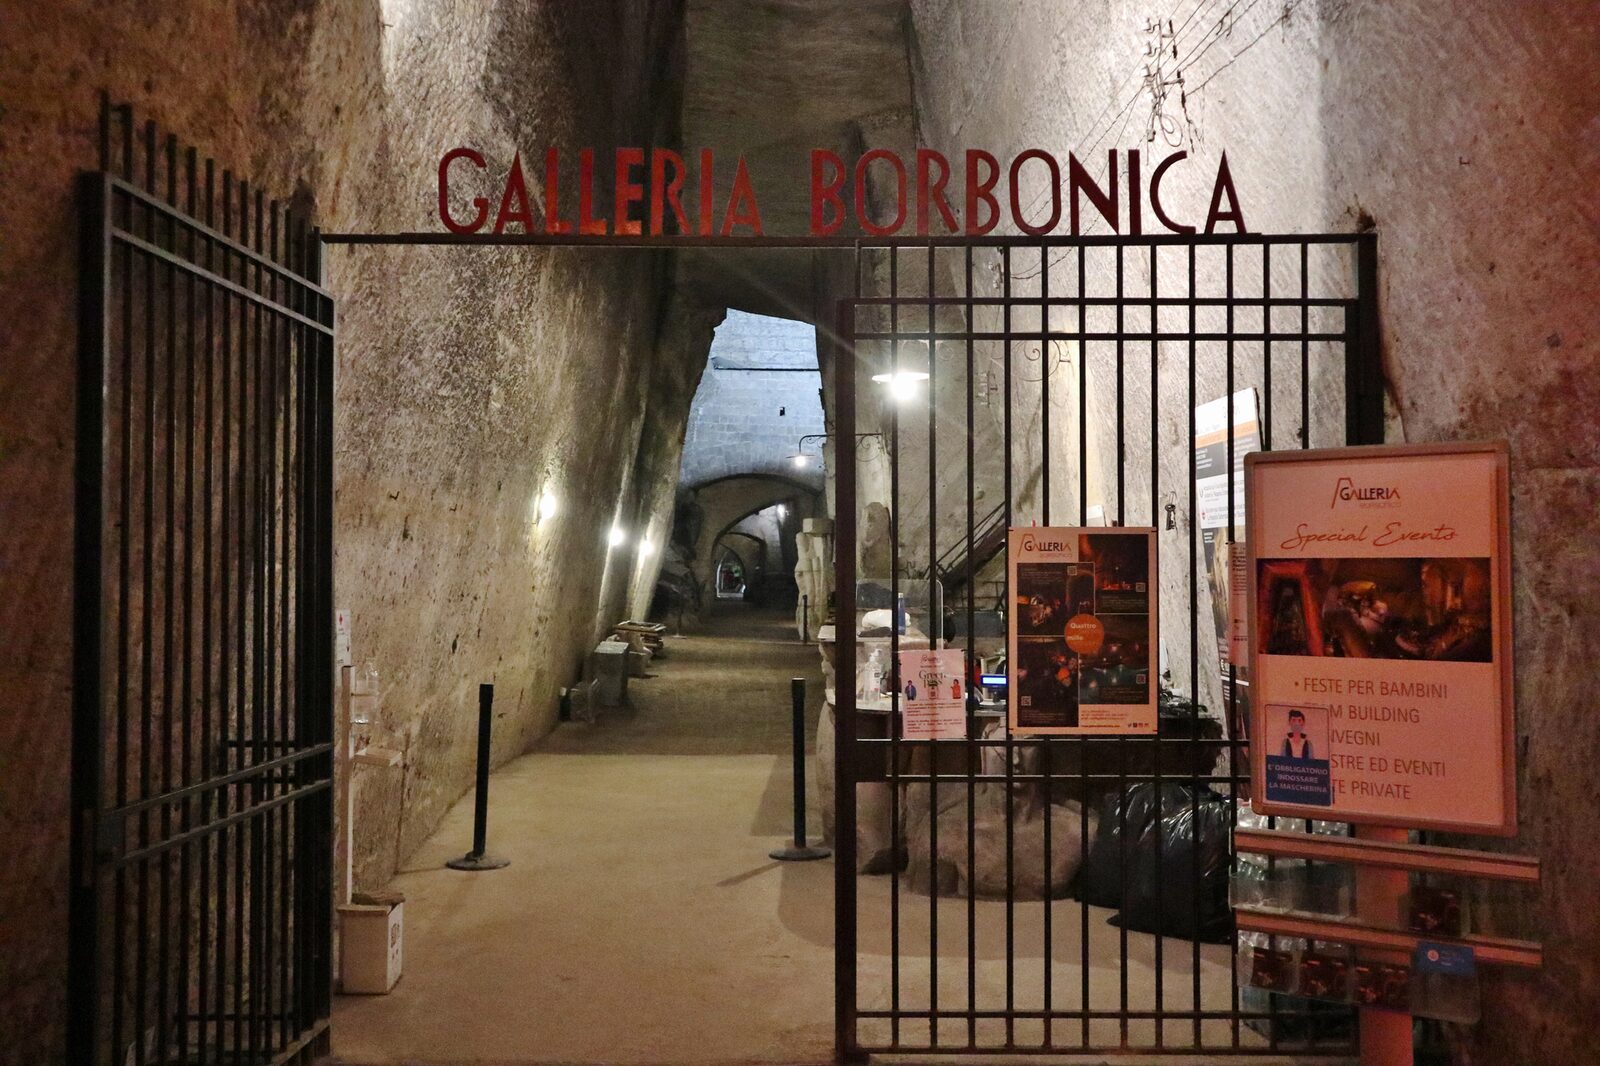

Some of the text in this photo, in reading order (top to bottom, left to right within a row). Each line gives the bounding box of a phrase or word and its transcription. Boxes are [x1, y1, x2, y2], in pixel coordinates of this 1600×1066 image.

[438, 147, 1248, 237] GALLERIA BORBONICA
[1339, 486, 1401, 501] GALLERIA
[1280, 521, 1458, 551] Special Events
[1024, 540, 1072, 552] GALLERIA
[1303, 677, 1448, 699] FESTE PER BAMBINI
[1349, 704, 1420, 724] BUILDING
[1331, 729, 1381, 747] VEGNI
[1274, 764, 1328, 776] OBBLIGATORIO
[1331, 753, 1446, 777] STRE ED EVENTI
[1277, 773, 1319, 784] INDOSSARE
[1280, 782, 1327, 793] MASCHERINA
[1351, 780, 1411, 800] PRIVATE
